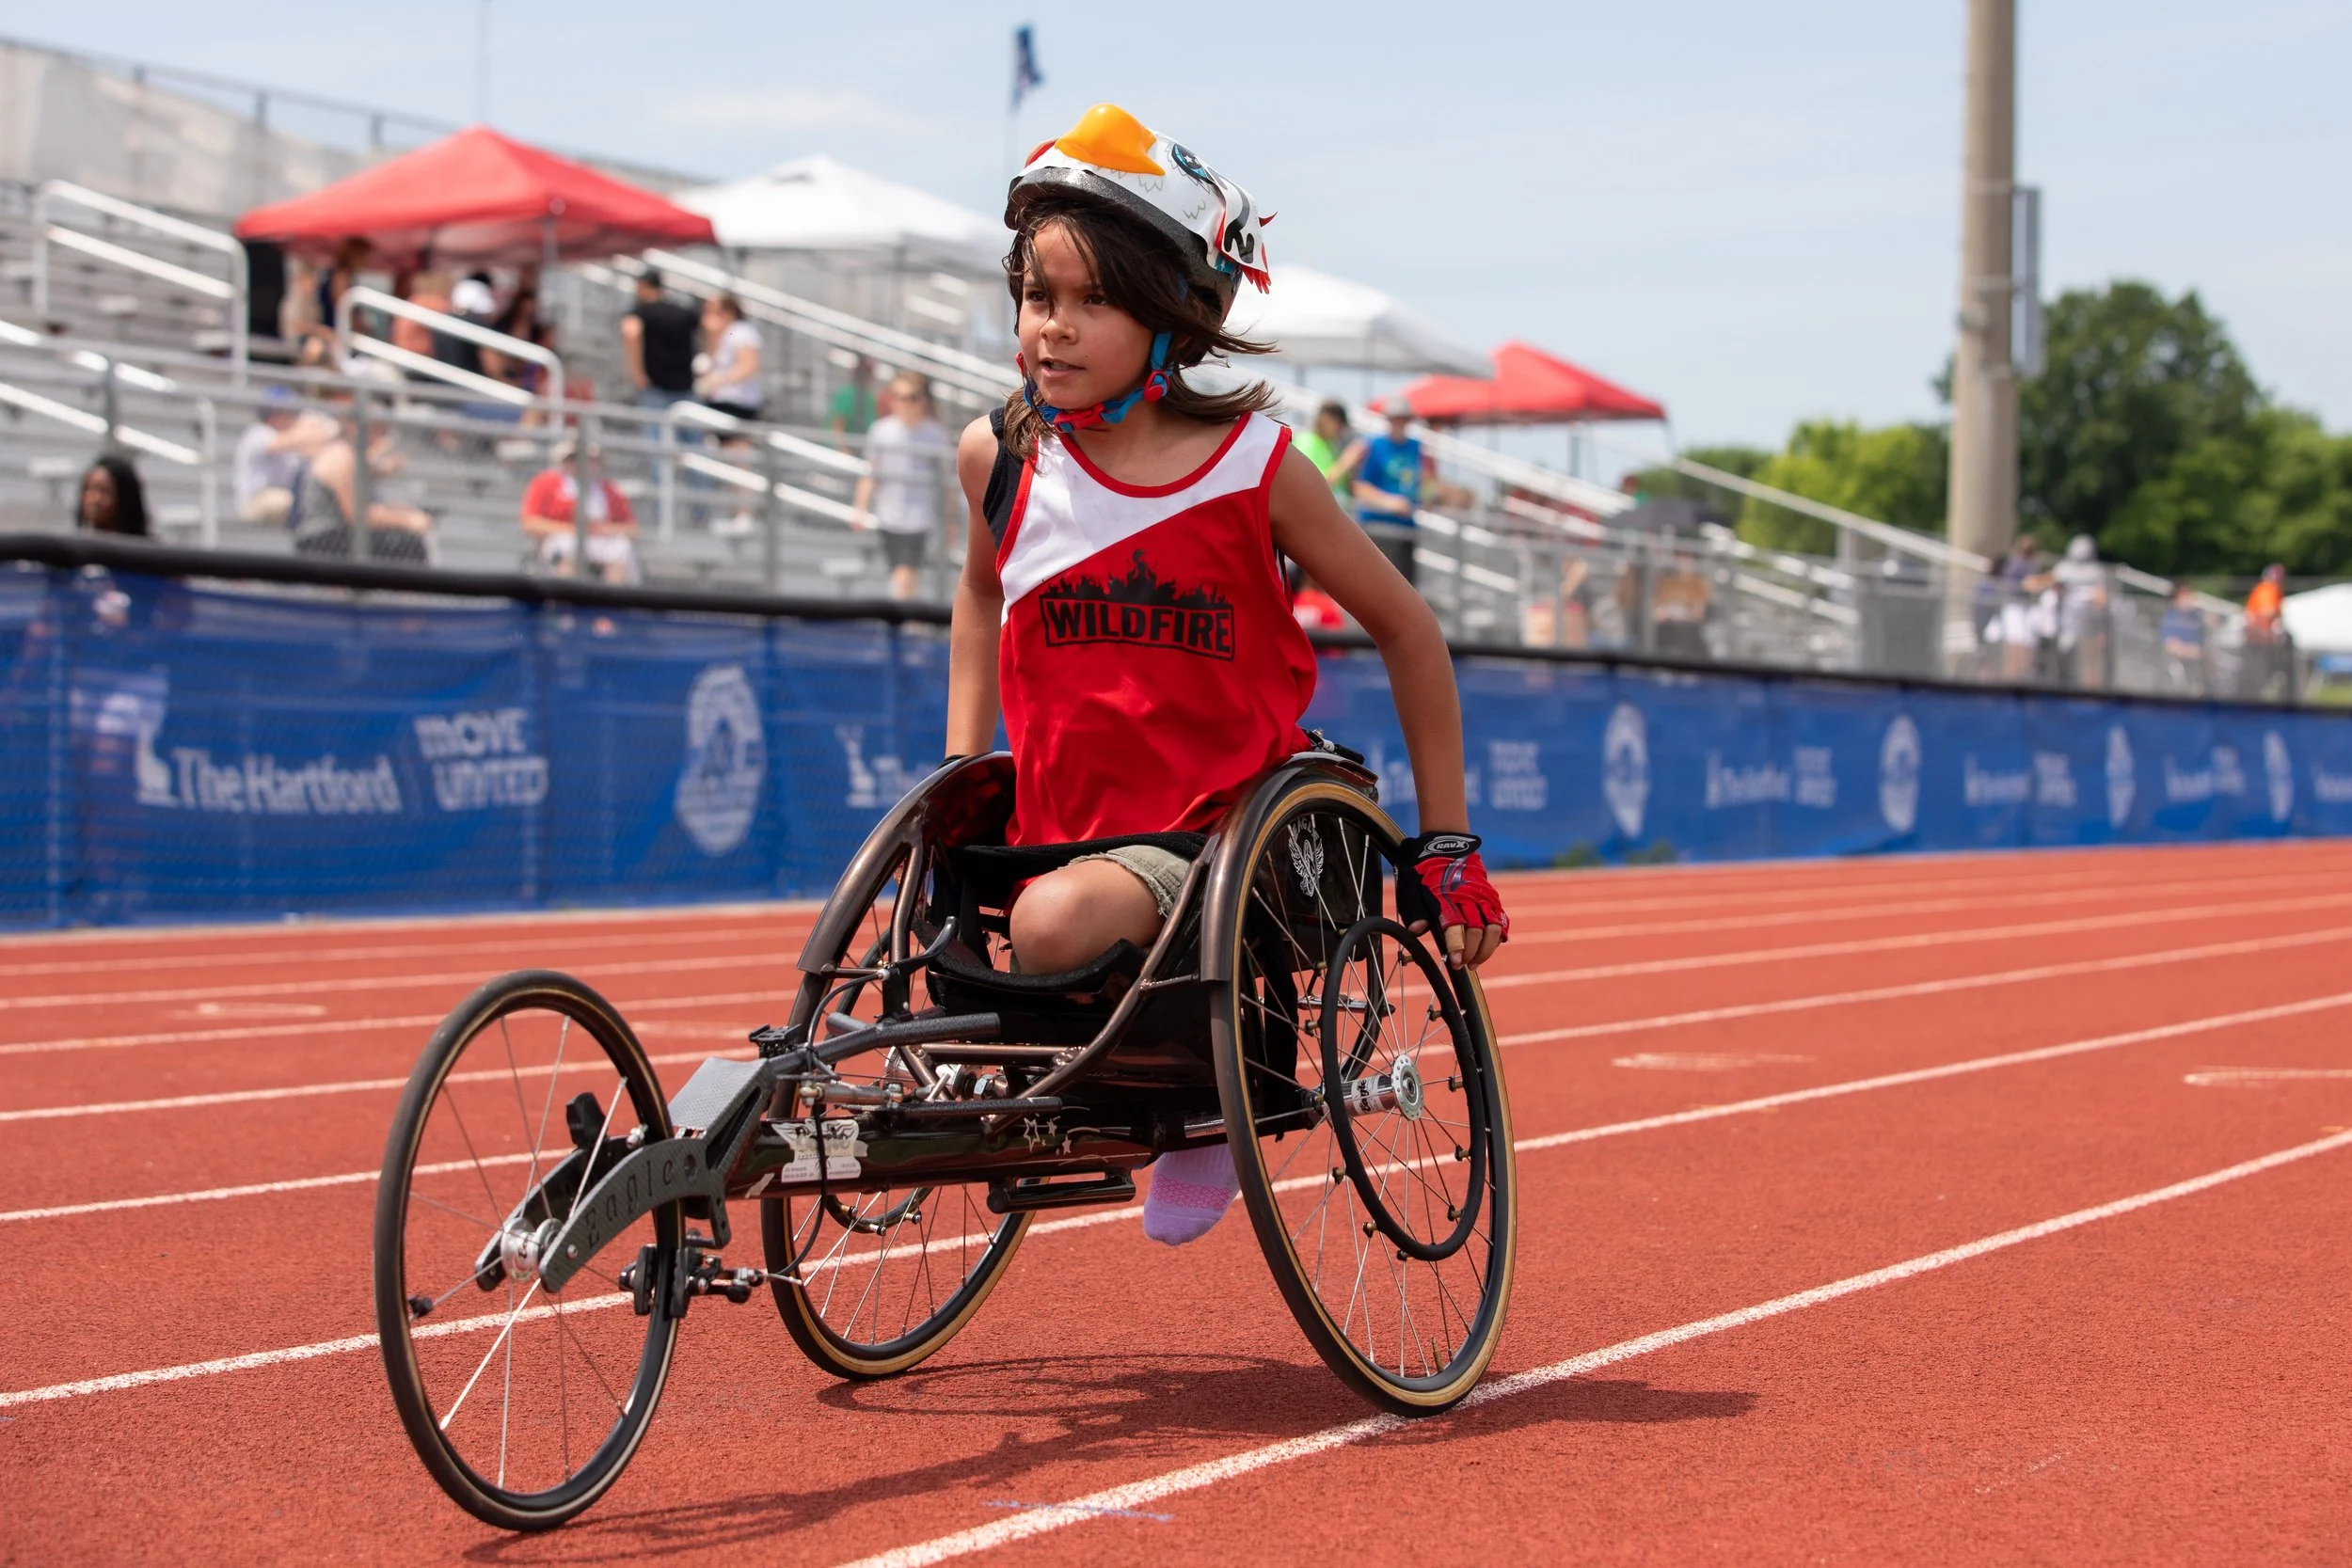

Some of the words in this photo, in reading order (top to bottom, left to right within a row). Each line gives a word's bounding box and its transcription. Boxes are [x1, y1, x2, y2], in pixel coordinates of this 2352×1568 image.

[1046, 600, 1231, 653] WILDFIRE
[432, 755, 549, 812] UNITED
[584, 1160, 675, 1248] Eagle
